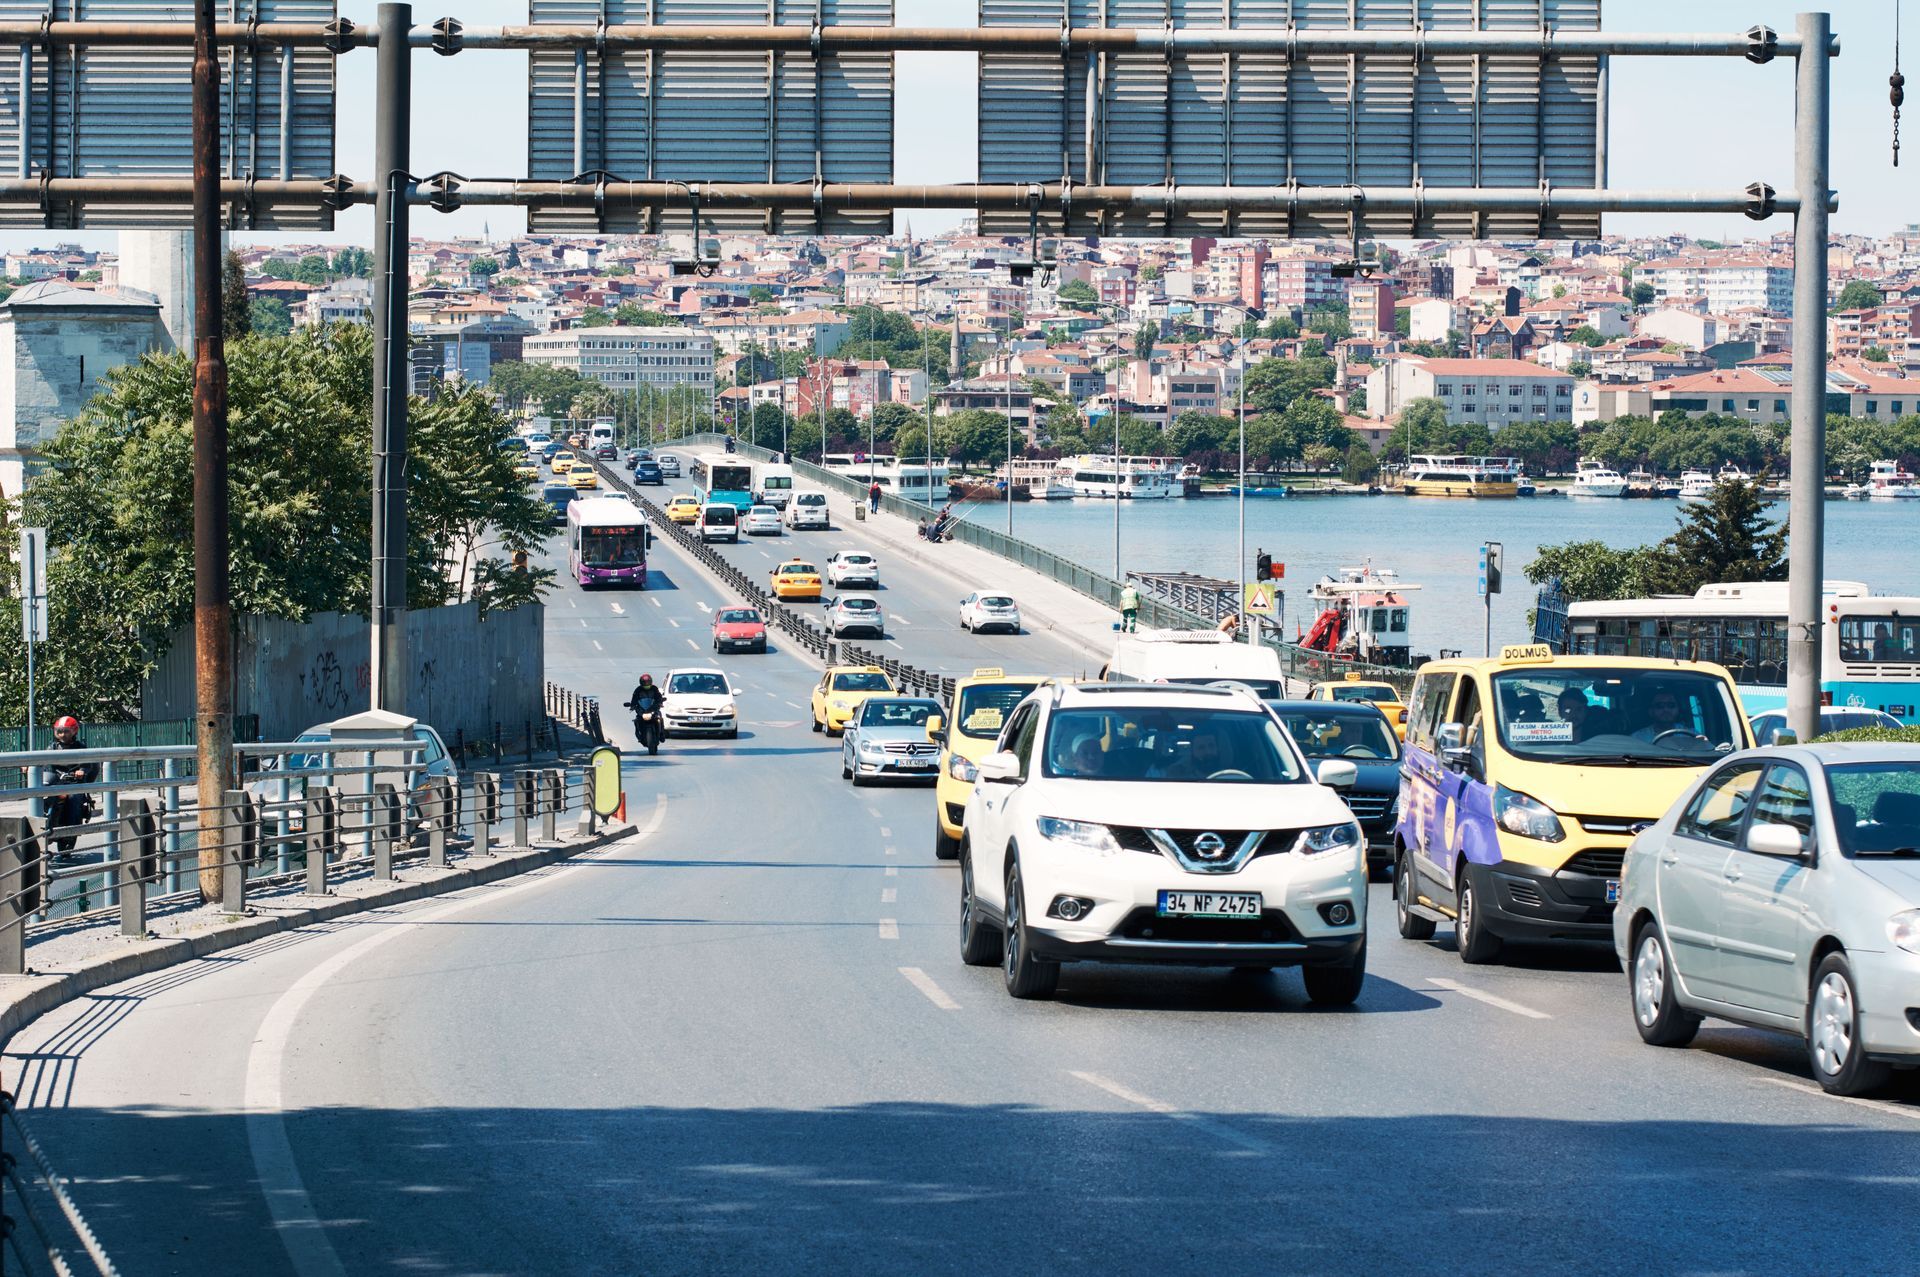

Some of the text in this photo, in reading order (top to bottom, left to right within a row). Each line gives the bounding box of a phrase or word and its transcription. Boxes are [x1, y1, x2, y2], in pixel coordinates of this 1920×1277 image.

[1505, 647, 1548, 659] DOLMUŞ
[1168, 894, 1186, 911] 34
[1219, 896, 1256, 913] 2475
